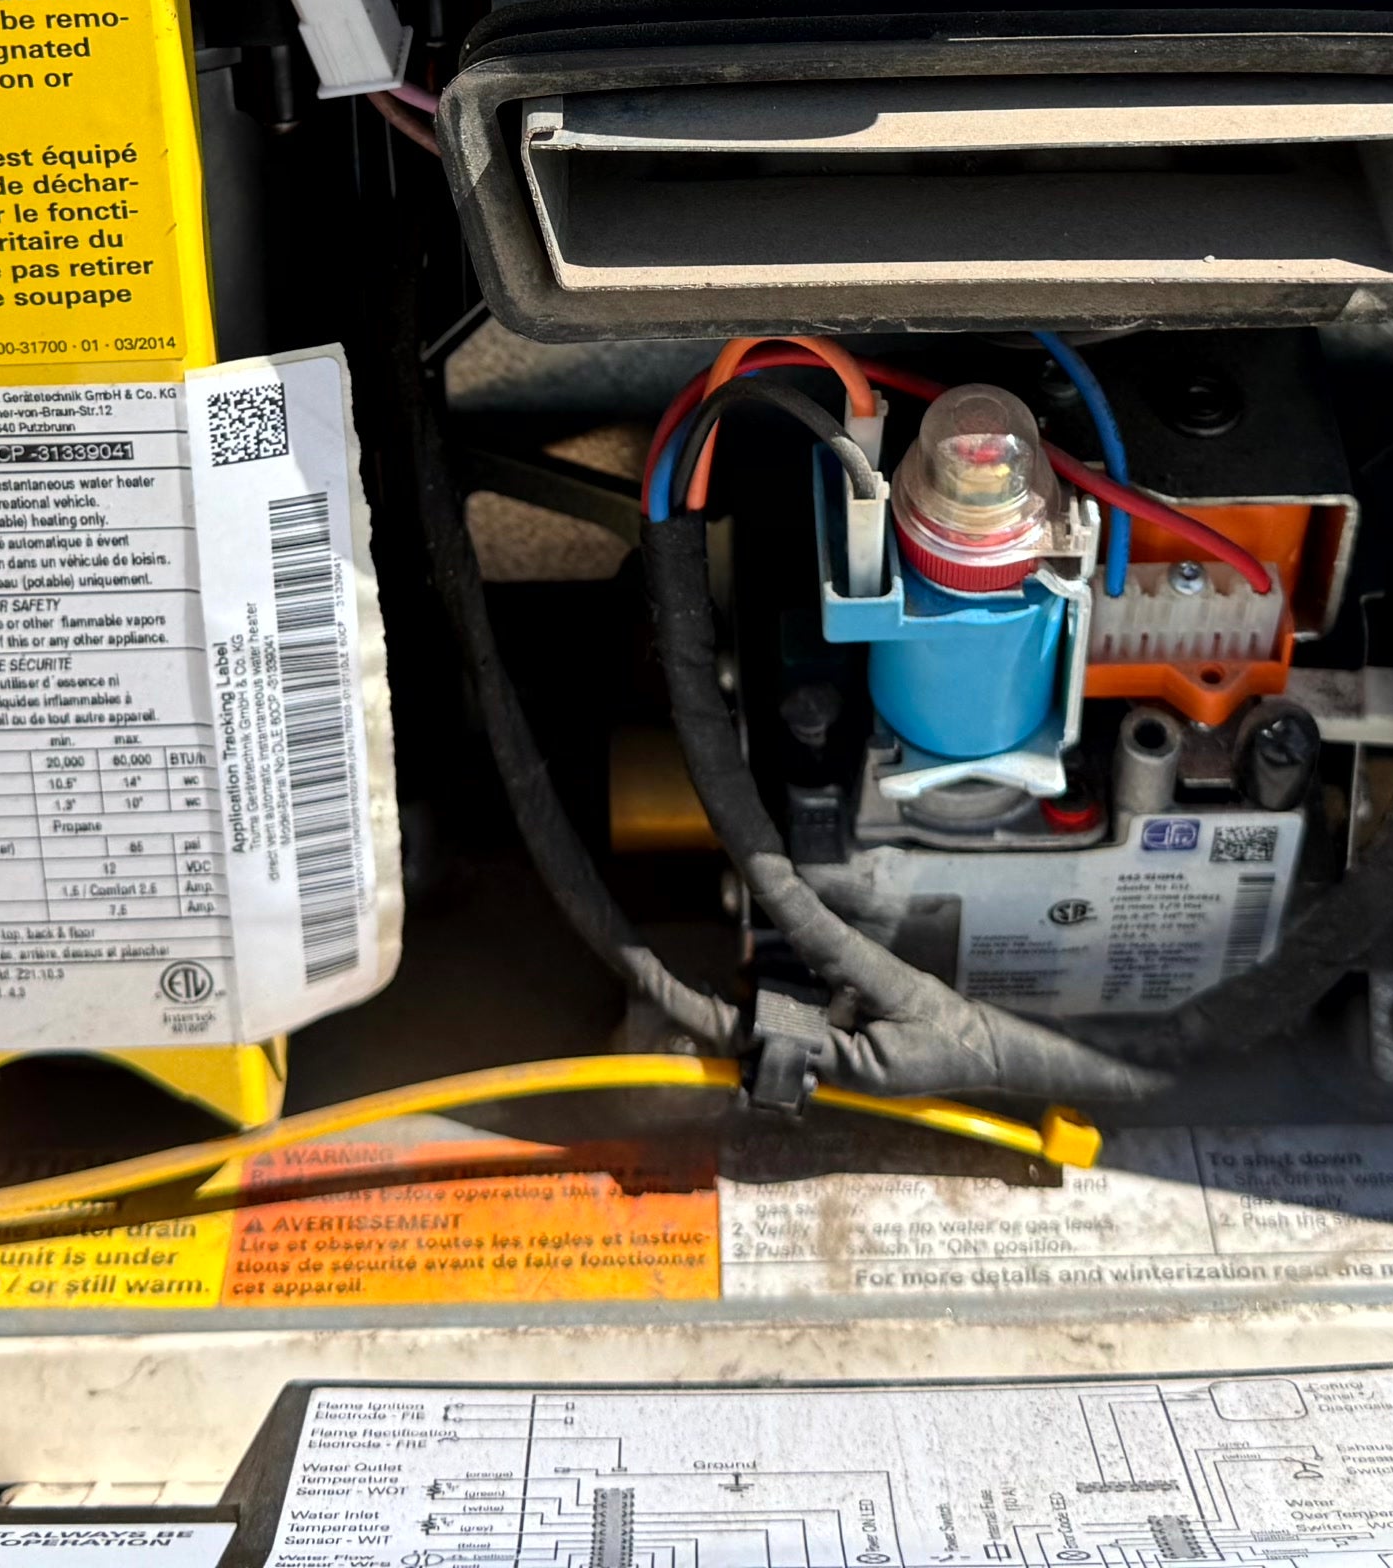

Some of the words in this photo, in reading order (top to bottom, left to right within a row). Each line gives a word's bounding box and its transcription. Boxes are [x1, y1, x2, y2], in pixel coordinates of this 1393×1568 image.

[0, 10, 34, 29] be
[46, 12, 128, 28] remo-
[45, 73, 73, 87] or
[42, 143, 136, 169] équipé
[33, 173, 138, 194] déchar-
[14, 204, 38, 222] le
[47, 200, 138, 221] foncti-
[89, 229, 123, 248] du
[12, 264, 59, 283] pas
[70, 257, 153, 276] retirer
[14, 289, 131, 309] soupape
[81, 339, 98, 352] 01
[114, 337, 176, 351] 03/2014
[85, 390, 121, 401] GmbH
[125, 389, 132, 400] &
[136, 389, 156, 399] Co.
[160, 388, 176, 398] KG
[80, 477, 113, 489] water
[117, 476, 154, 488] heater
[12, 599, 60, 612] SAFETY
[214, 641, 230, 688] Label
[220, 692, 238, 760] Tracking
[227, 763, 246, 853] Application
[53, 820, 102, 833] Propane
[272, 1214, 463, 1232] AVERTISSEMENT
[0, 1246, 57, 1265] unit
[63, 1246, 85, 1265] is
[95, 1247, 178, 1266] under
[854, 1269, 895, 1287] For
[903, 1269, 964, 1285] more
[972, 1265, 1050, 1285] details
[1059, 1264, 1103, 1283] and
[1110, 1261, 1268, 1283] winterization
[6, 1277, 19, 1293] /
[28, 1279, 57, 1294] or
[66, 1274, 115, 1294] still
[125, 1278, 210, 1294] warm.
[303, 1463, 350, 1472] Water
[355, 1463, 402, 1472] Outlet
[694, 1459, 758, 1471] Ground
[0, 1538, 172, 1547] OPERATION
[20, 1530, 147, 1539] ALWAYS
[152, 1529, 194, 1539] BE
